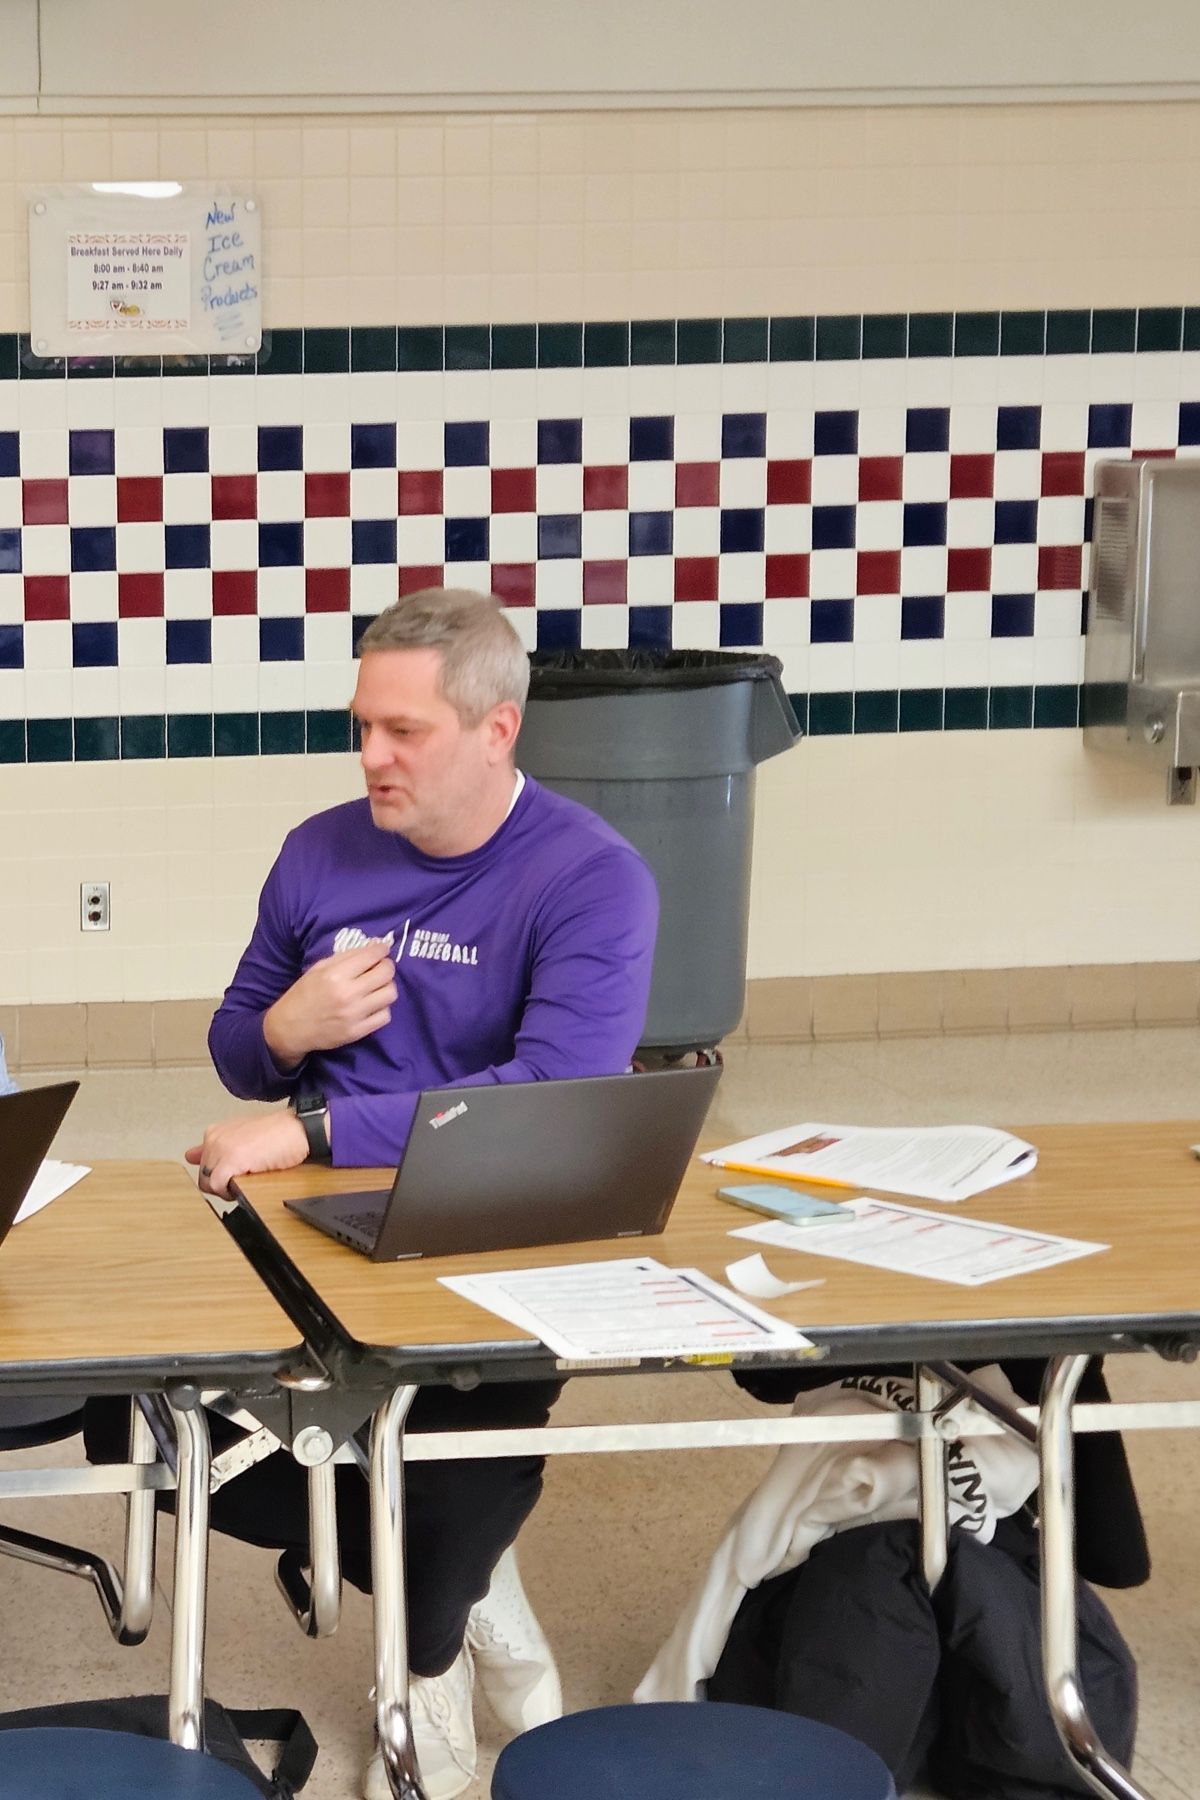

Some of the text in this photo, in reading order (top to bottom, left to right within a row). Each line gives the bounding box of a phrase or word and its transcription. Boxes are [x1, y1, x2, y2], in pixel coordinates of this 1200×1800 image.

[205, 201, 236, 230] New
[70, 246, 184, 259] Breakfast Served Here Daily
[207, 232, 245, 255] Ice
[112, 265, 126, 273] am
[151, 265, 164, 273] am
[203, 253, 255, 283] Cream
[92, 280, 109, 291] 9:27
[111, 282, 124, 290] am
[130, 280, 148, 290] 9:32
[150, 281, 163, 290] am
[201, 282, 258, 312] Products
[409, 939, 478, 965] BASEBALL
